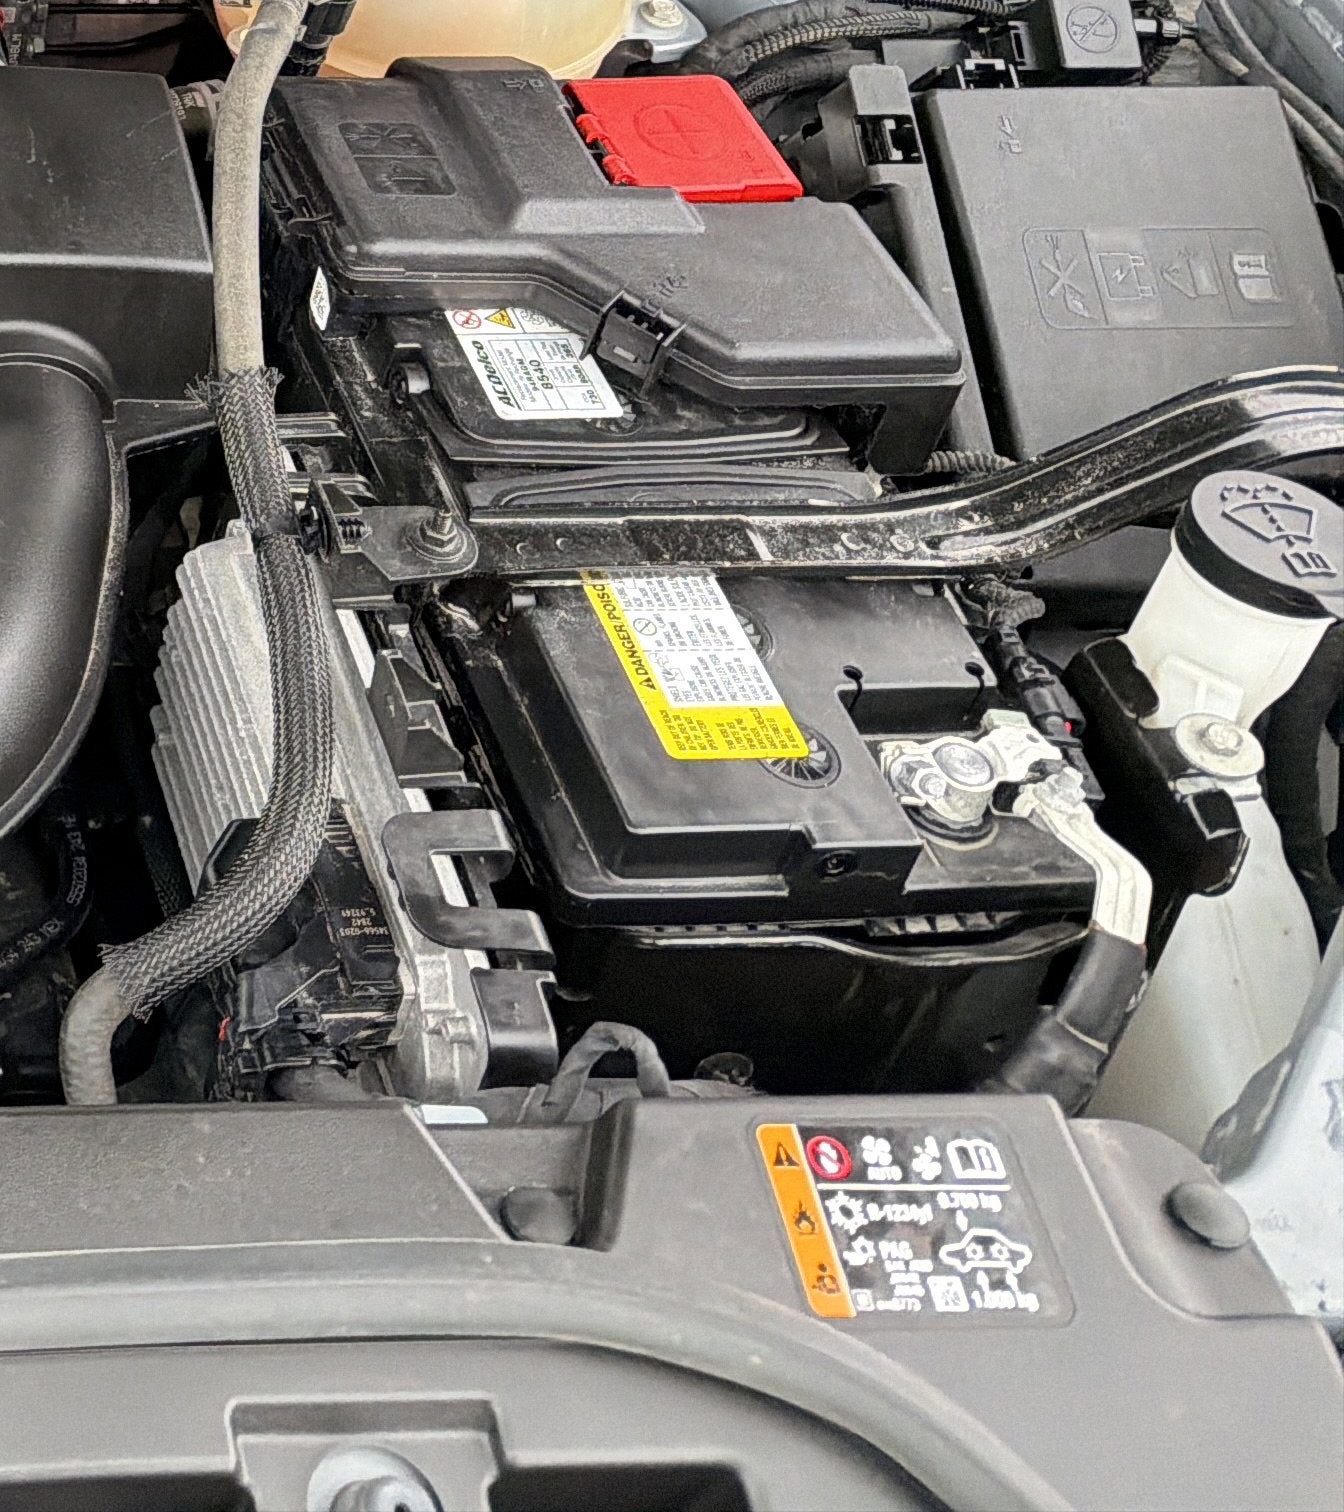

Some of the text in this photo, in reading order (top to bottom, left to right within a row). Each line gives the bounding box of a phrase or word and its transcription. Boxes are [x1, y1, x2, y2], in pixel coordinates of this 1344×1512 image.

[471, 340, 515, 408] ACDelco
[527, 359, 554, 389] 8540
[593, 578, 650, 677] DANGER/POISO
[868, 1165, 902, 1181] AUTO
